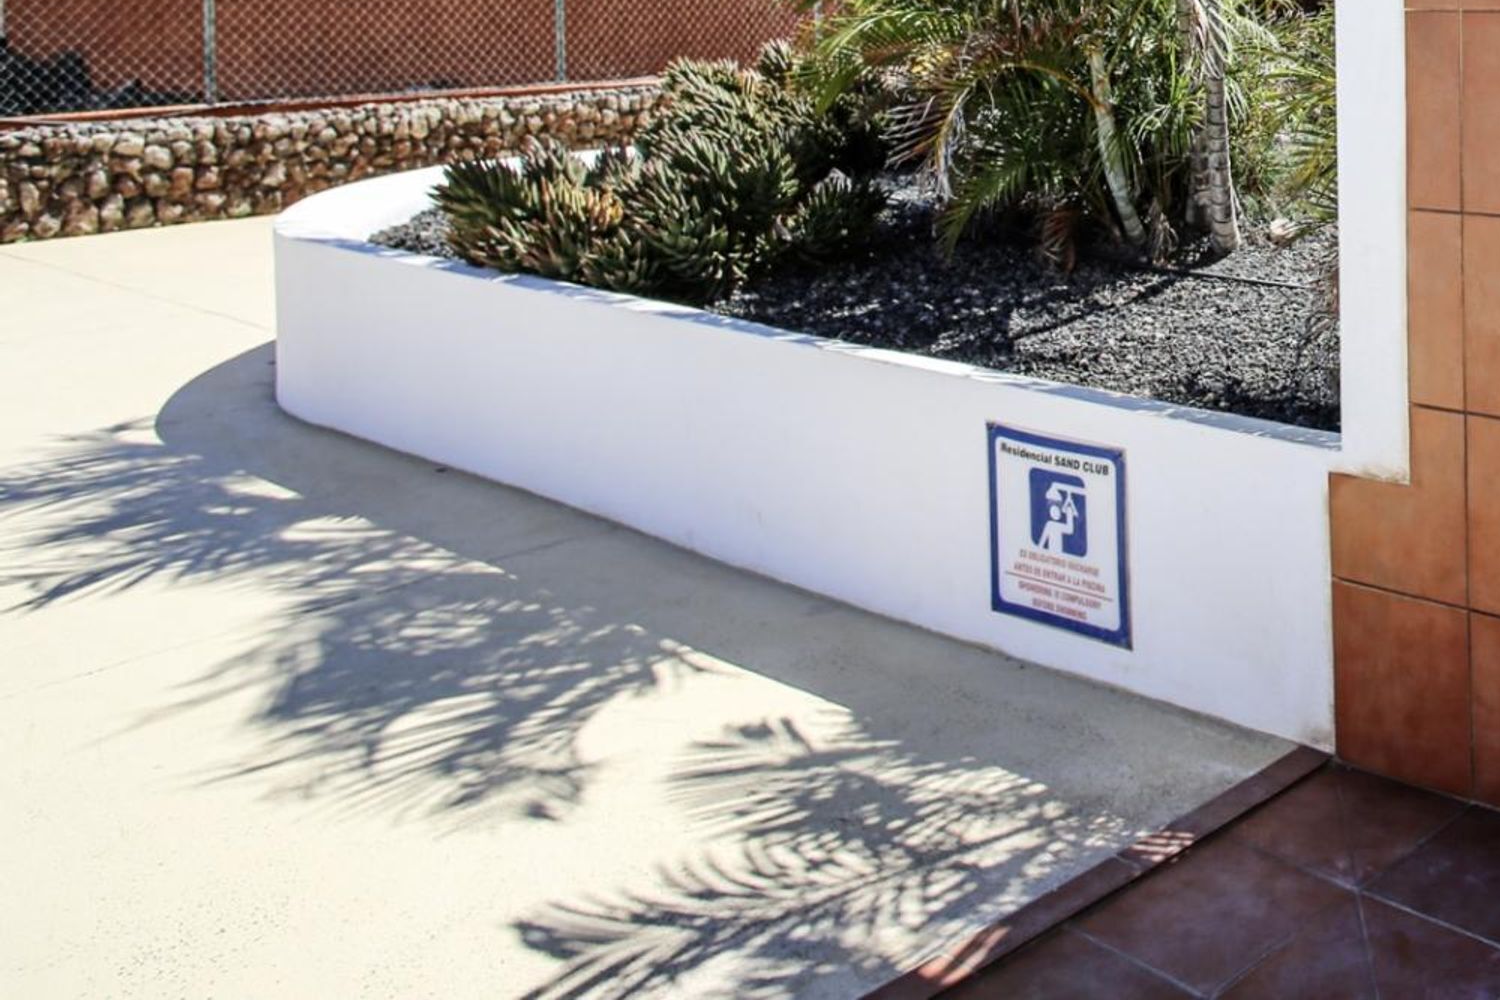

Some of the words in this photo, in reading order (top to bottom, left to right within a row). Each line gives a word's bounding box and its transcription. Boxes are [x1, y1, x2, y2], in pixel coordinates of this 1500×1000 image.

[1000, 442, 1052, 464] Residencial
[1054, 455, 1080, 470] SAND
[1083, 461, 1109, 476] CLUB
[1073, 576, 1080, 586] LA
